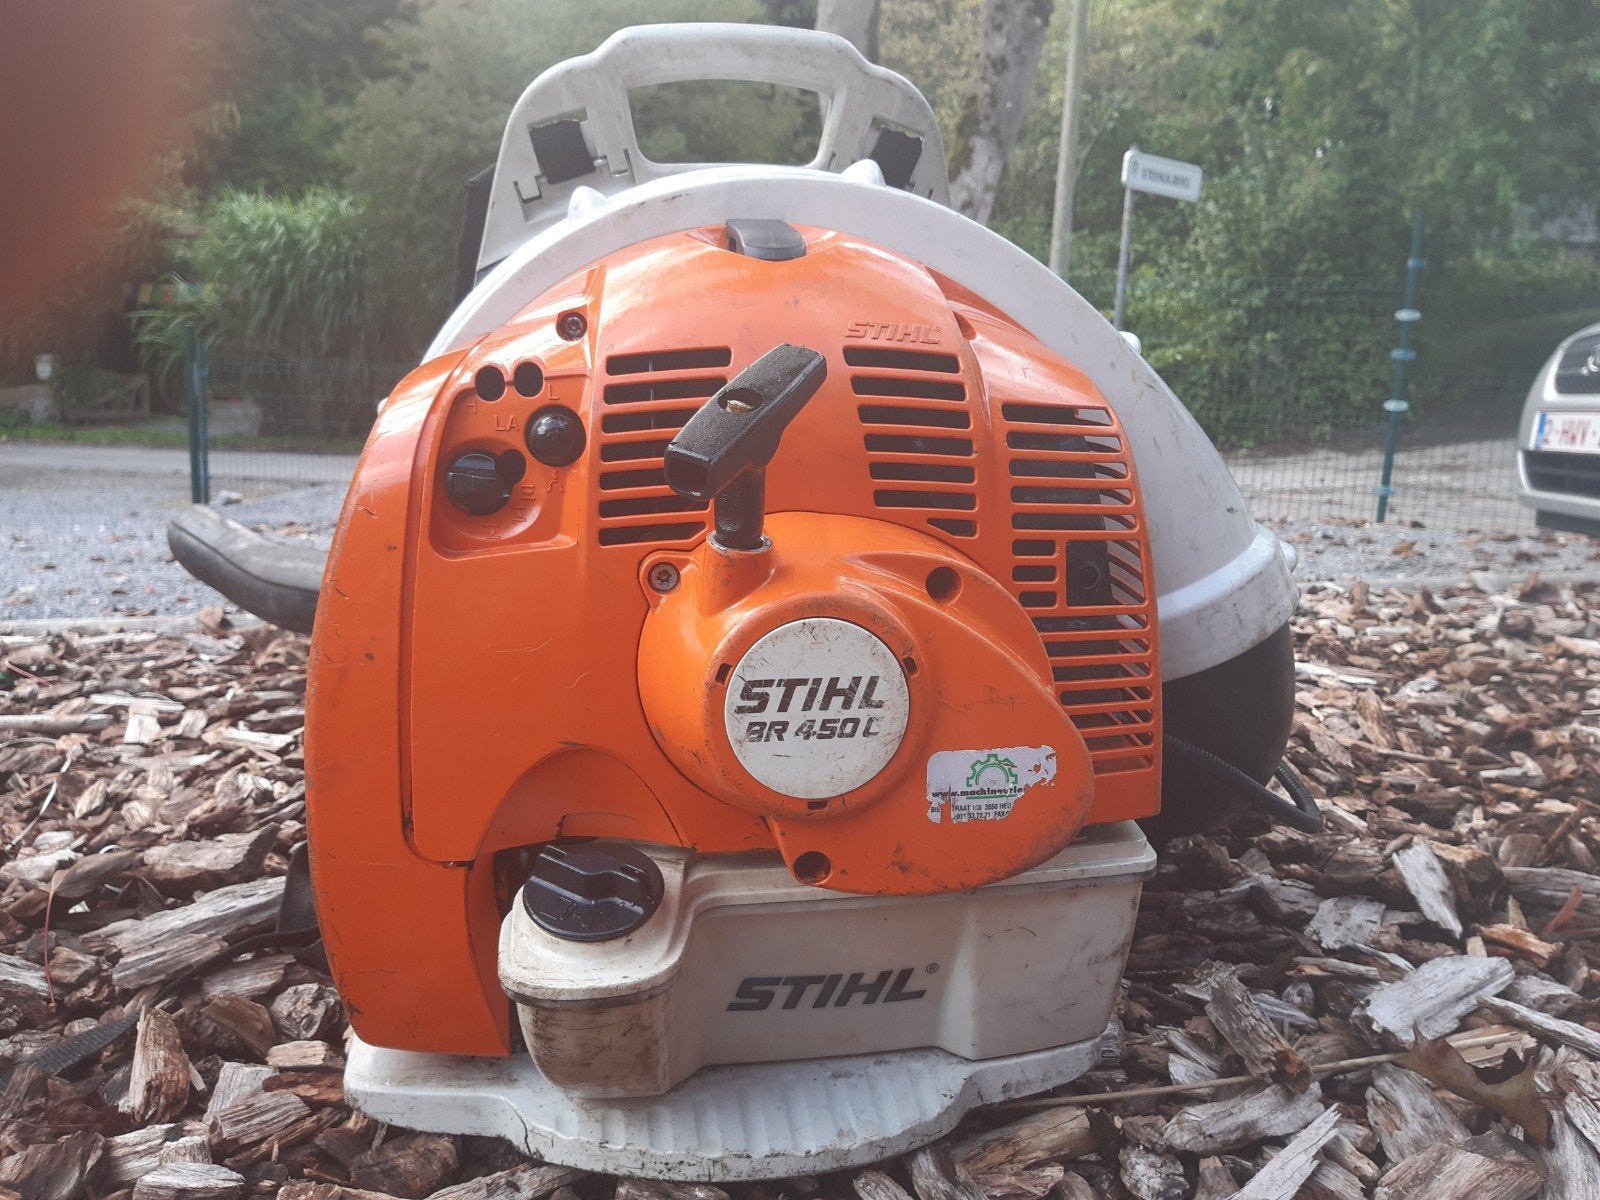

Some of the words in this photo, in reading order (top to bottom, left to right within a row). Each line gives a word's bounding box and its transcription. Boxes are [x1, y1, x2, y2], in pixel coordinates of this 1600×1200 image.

[843, 319, 941, 345] STIHL
[494, 414, 521, 432] LA
[734, 675, 885, 715] STIHL
[745, 719, 790, 743] BR
[794, 716, 861, 741] 450
[862, 716, 881, 738] C
[726, 967, 927, 1012] STIHL
